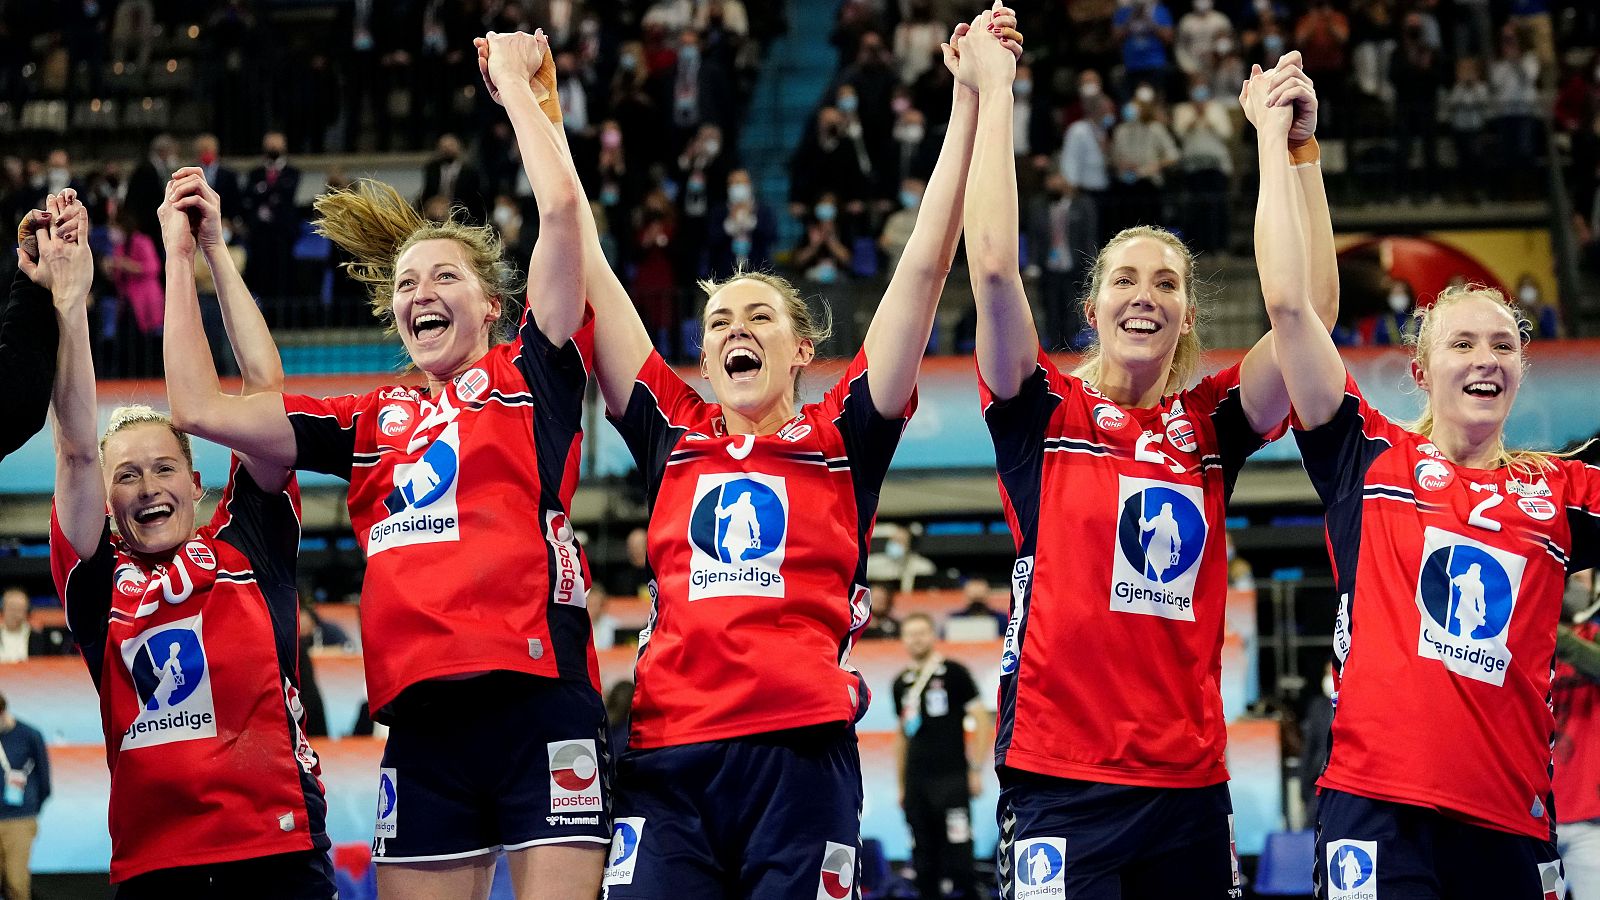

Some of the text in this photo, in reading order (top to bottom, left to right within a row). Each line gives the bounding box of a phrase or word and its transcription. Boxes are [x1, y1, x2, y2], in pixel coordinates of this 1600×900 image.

[407, 386, 460, 455] 24
[1103, 420, 1122, 428] NHF
[1426, 480, 1446, 488] NHF
[1467, 492, 1505, 532] 2
[371, 513, 456, 542] Gjensidige
[557, 542, 576, 603] osten
[692, 567, 781, 589] Gjensidige
[124, 584, 143, 595] NHF
[134, 556, 194, 619] 20
[1424, 629, 1505, 672] ensidige
[552, 794, 600, 809] posten
[559, 815, 599, 825] hummel
[1017, 885, 1063, 899] Gjensidige
